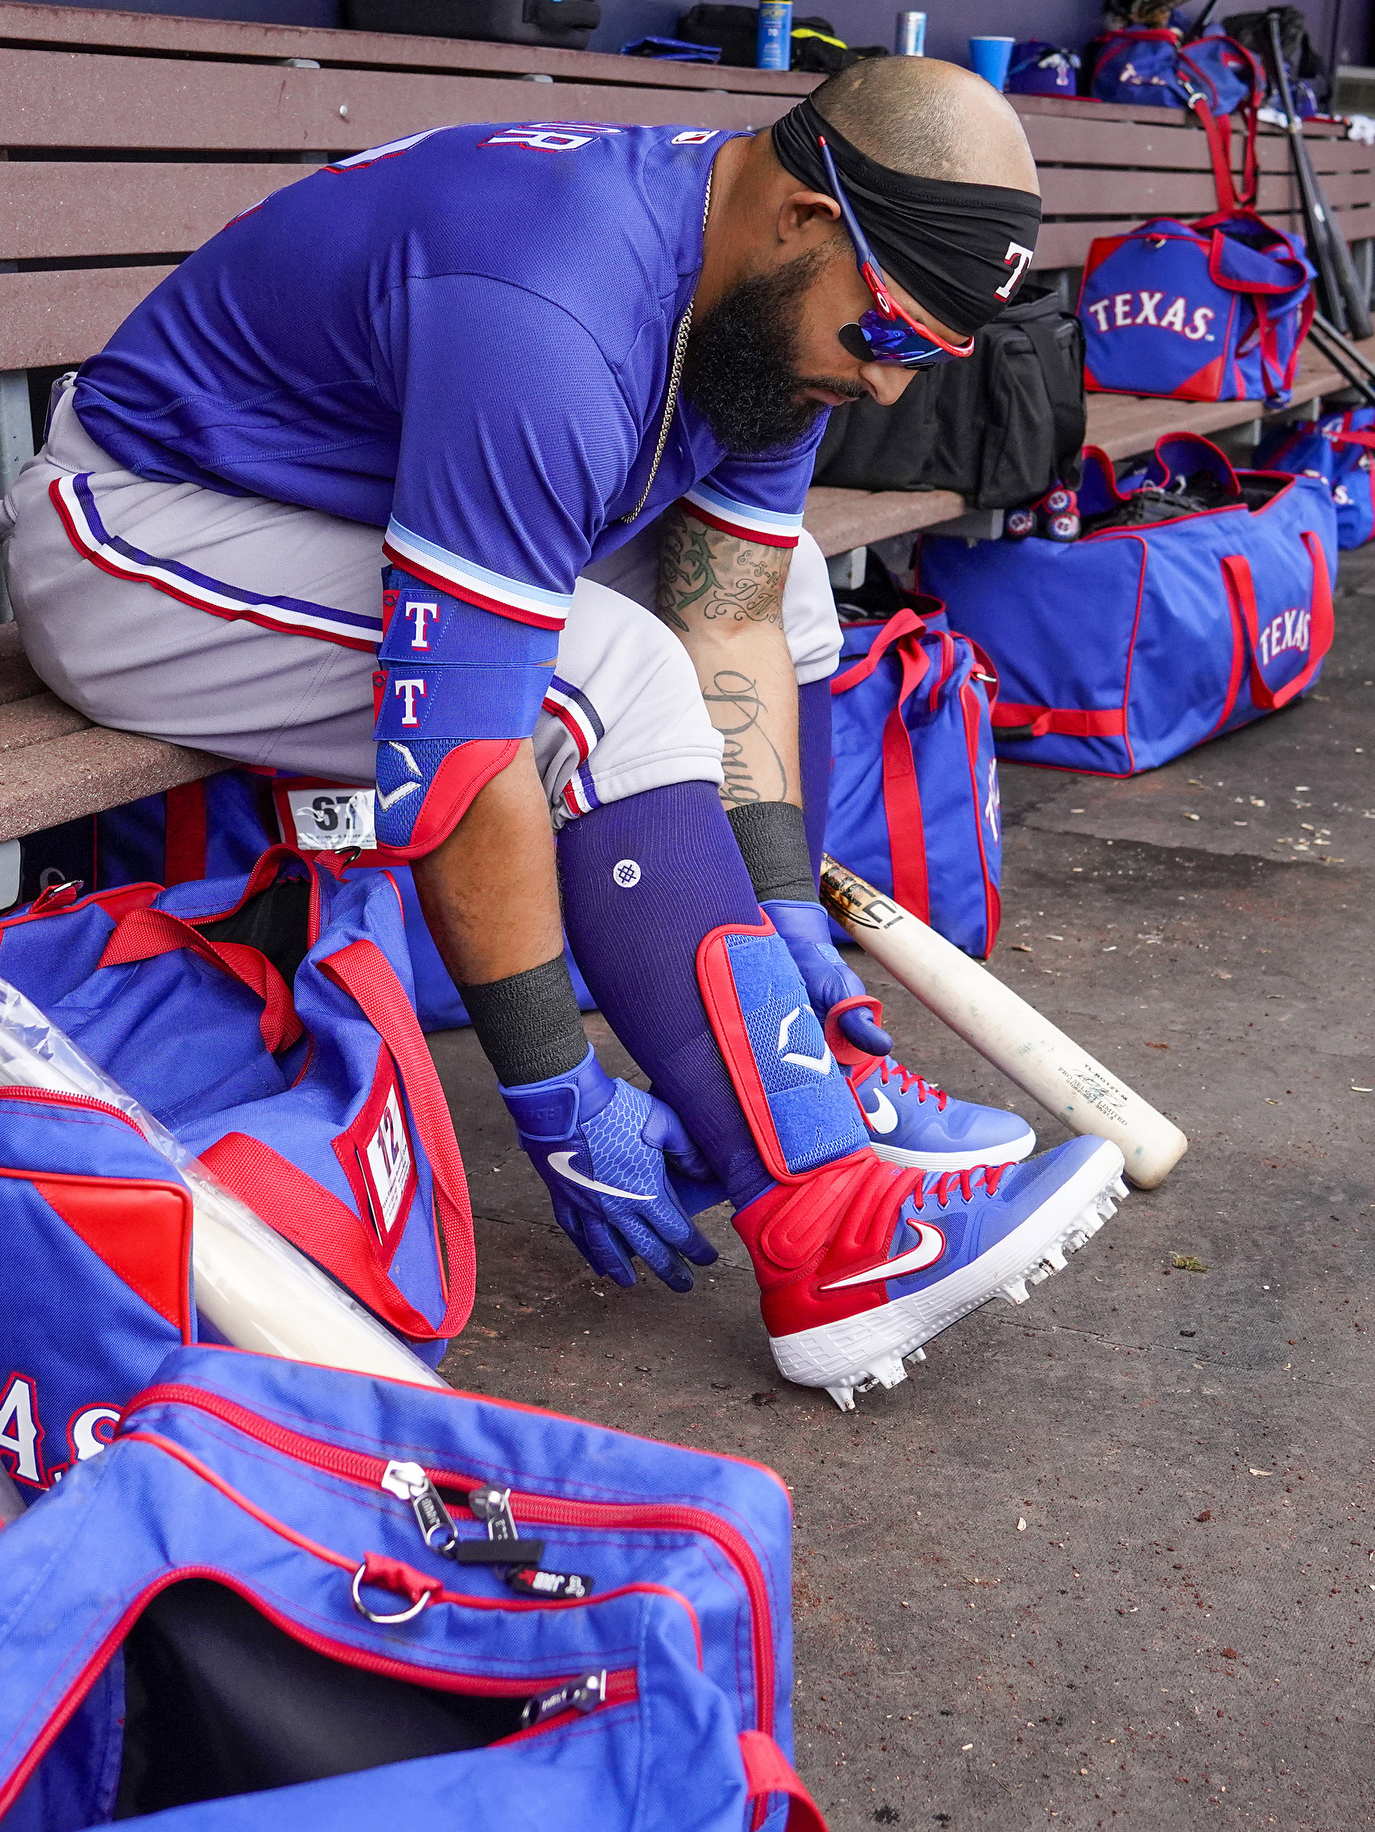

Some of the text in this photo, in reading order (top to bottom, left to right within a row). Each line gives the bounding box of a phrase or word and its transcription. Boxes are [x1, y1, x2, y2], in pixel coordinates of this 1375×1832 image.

[994, 242, 1034, 302] T
[1088, 290, 1216, 340] TEXAS
[405, 601, 441, 651] T
[1258, 607, 1312, 669] TEXAS
[394, 678, 428, 728] T
[1097, 1099, 1128, 1127] LIMITED
[378, 1105, 400, 1178] 12
